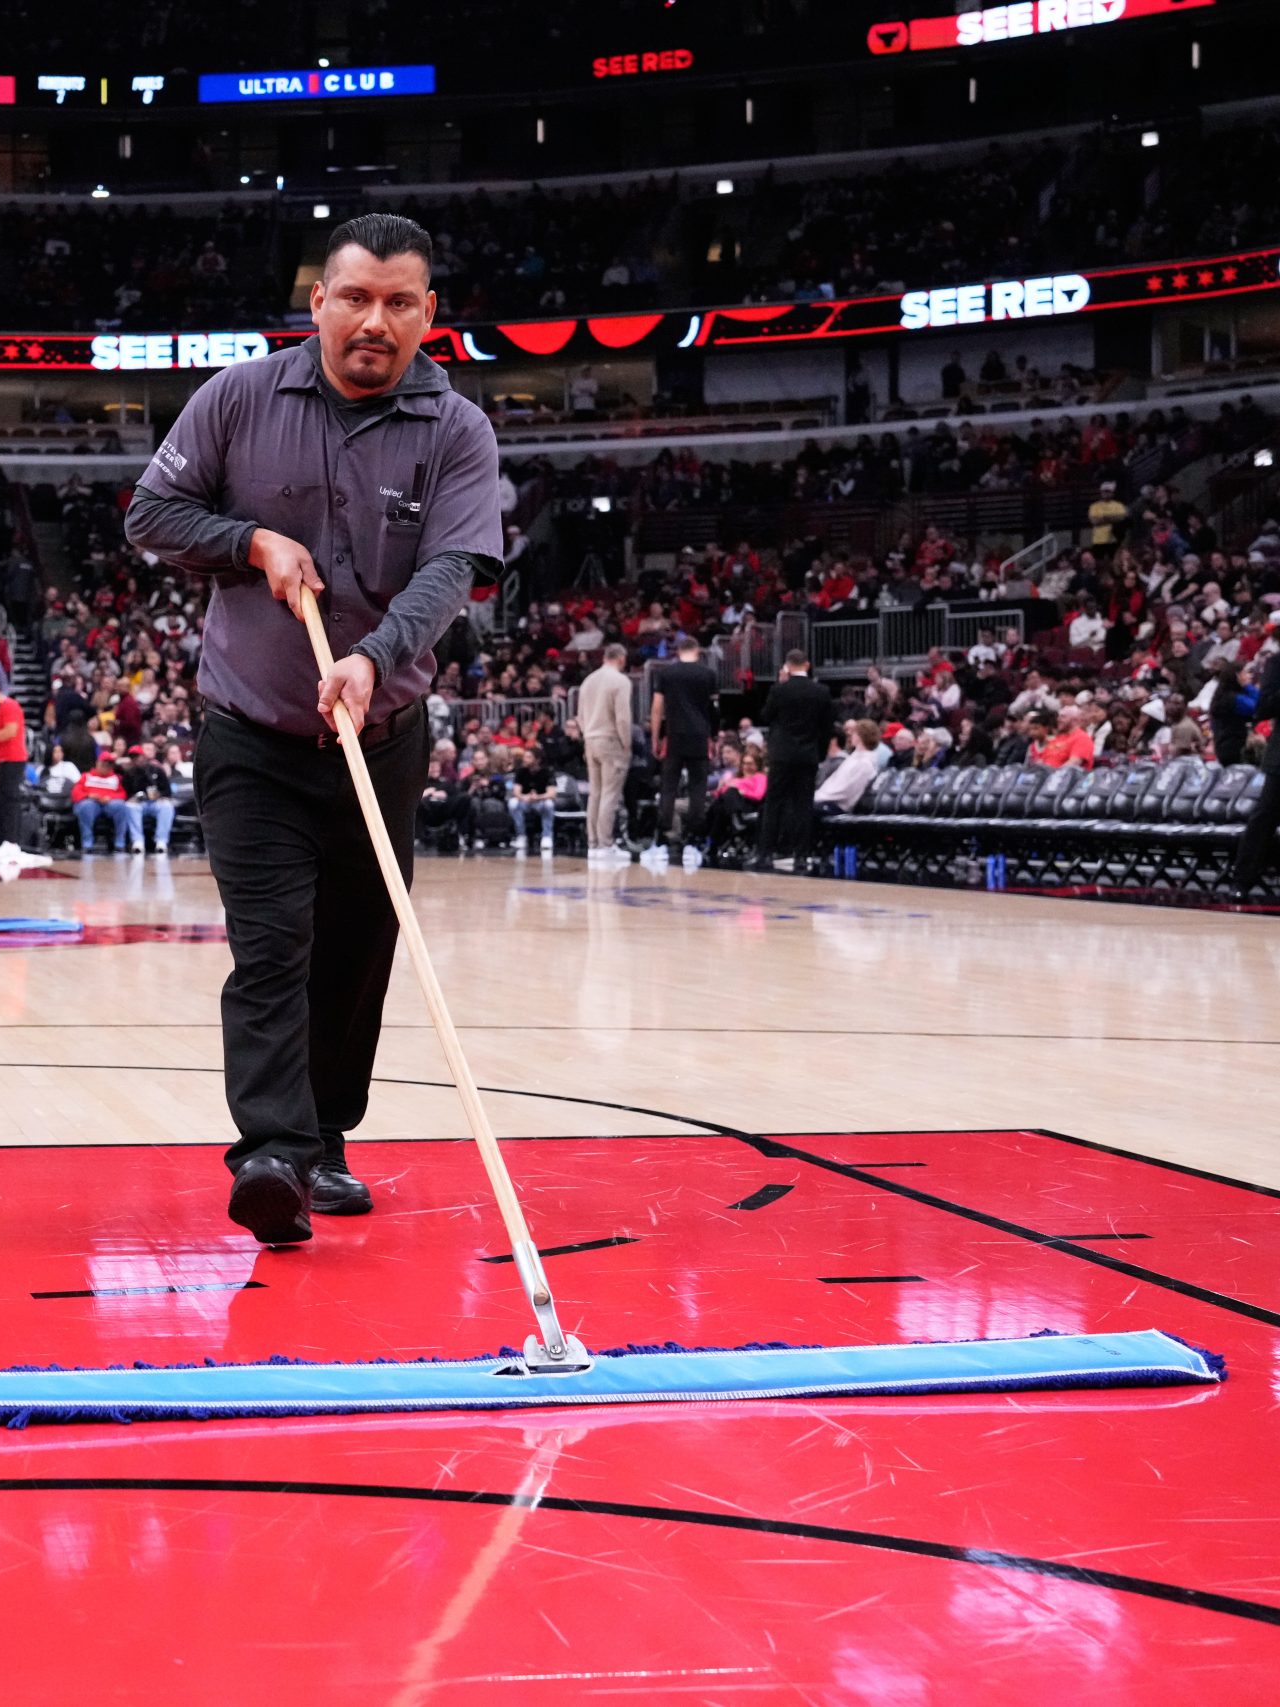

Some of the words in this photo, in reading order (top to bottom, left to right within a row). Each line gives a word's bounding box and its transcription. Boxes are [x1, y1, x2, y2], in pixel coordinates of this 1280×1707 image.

[956, 2, 1034, 45] SEE
[1037, 0, 1126, 32] RED
[593, 54, 639, 78] SEE
[641, 48, 693, 73] RED
[238, 77, 304, 95] ULTRA
[323, 72, 395, 91] CLUB
[900, 284, 986, 330] SEE
[991, 274, 1090, 321] RED
[90, 335, 173, 370] SEE
[177, 332, 270, 368] RED
[379, 485, 404, 499] United
